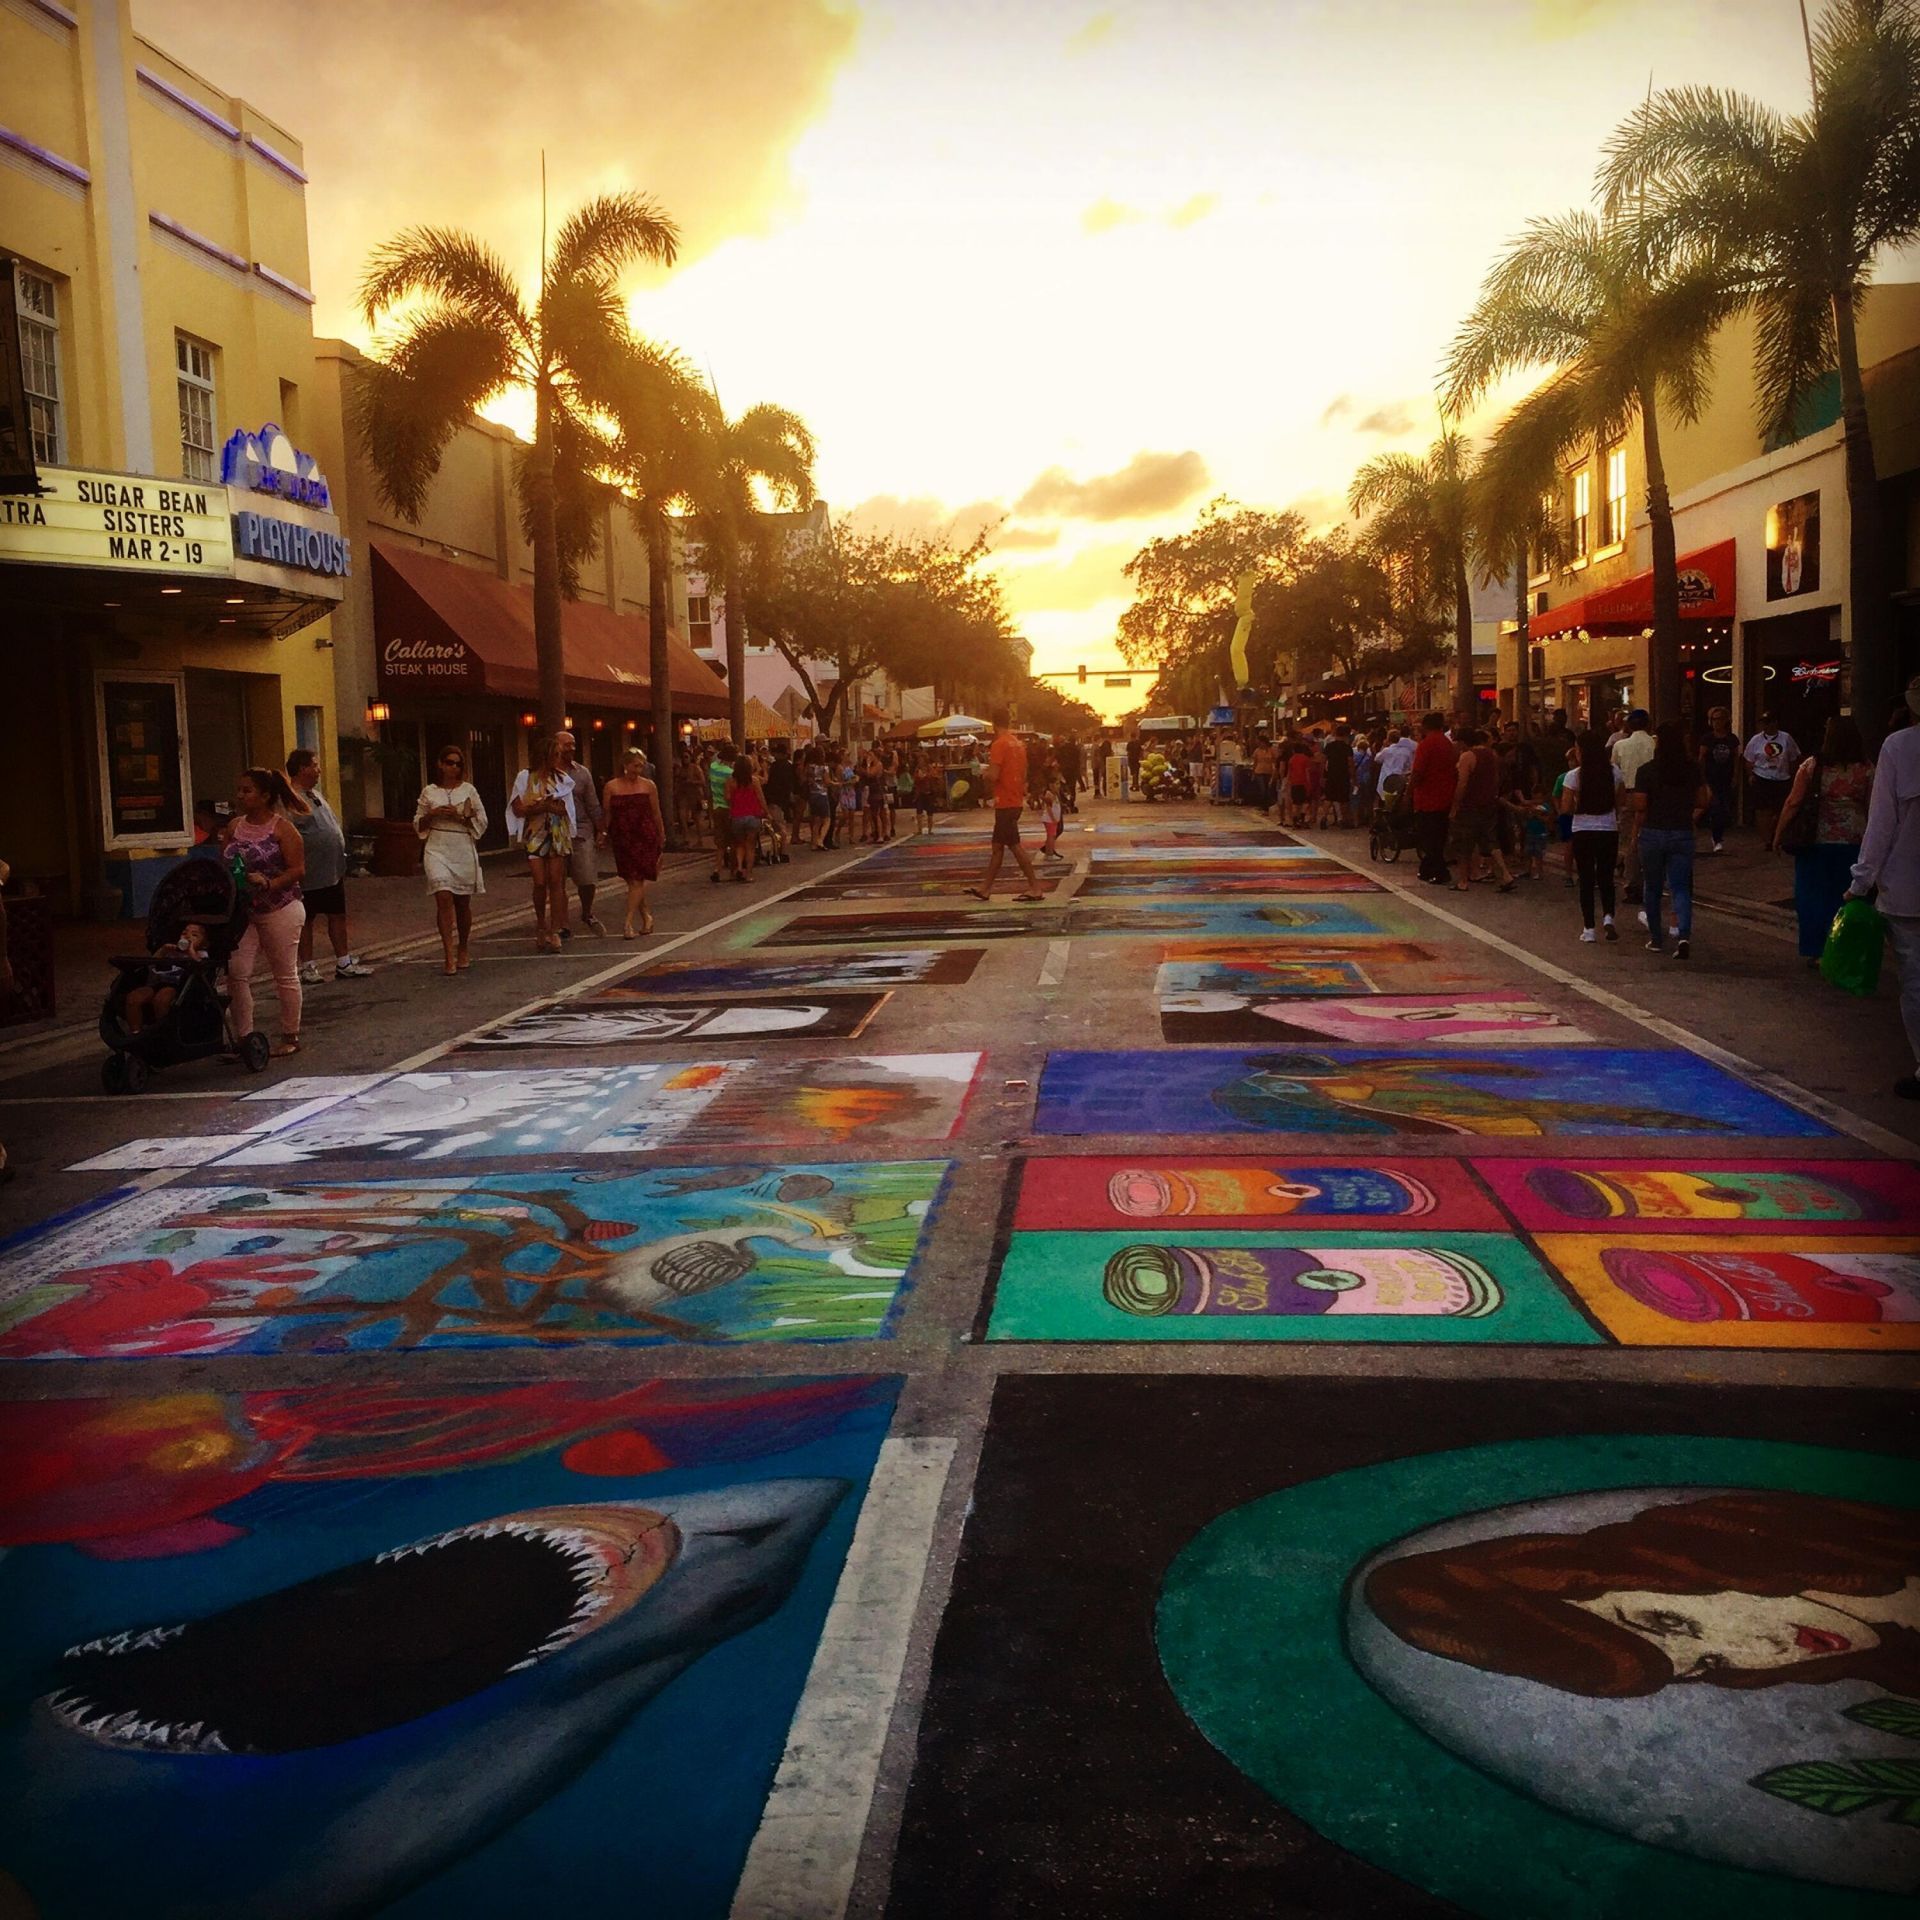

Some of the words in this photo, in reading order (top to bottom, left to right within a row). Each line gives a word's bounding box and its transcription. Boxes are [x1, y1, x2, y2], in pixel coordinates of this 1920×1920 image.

[77, 479, 145, 509] SUGAR
[159, 489, 208, 515] BEAN
[0, 500, 46, 525] TRA
[103, 509, 185, 538] SISTERS
[109, 536, 152, 560] MAR
[246, 512, 352, 577] PLAYHOUSE
[384, 638, 466, 662] Callaro's
[385, 663, 424, 676] STEAK
[427, 663, 469, 675] HOUSE
